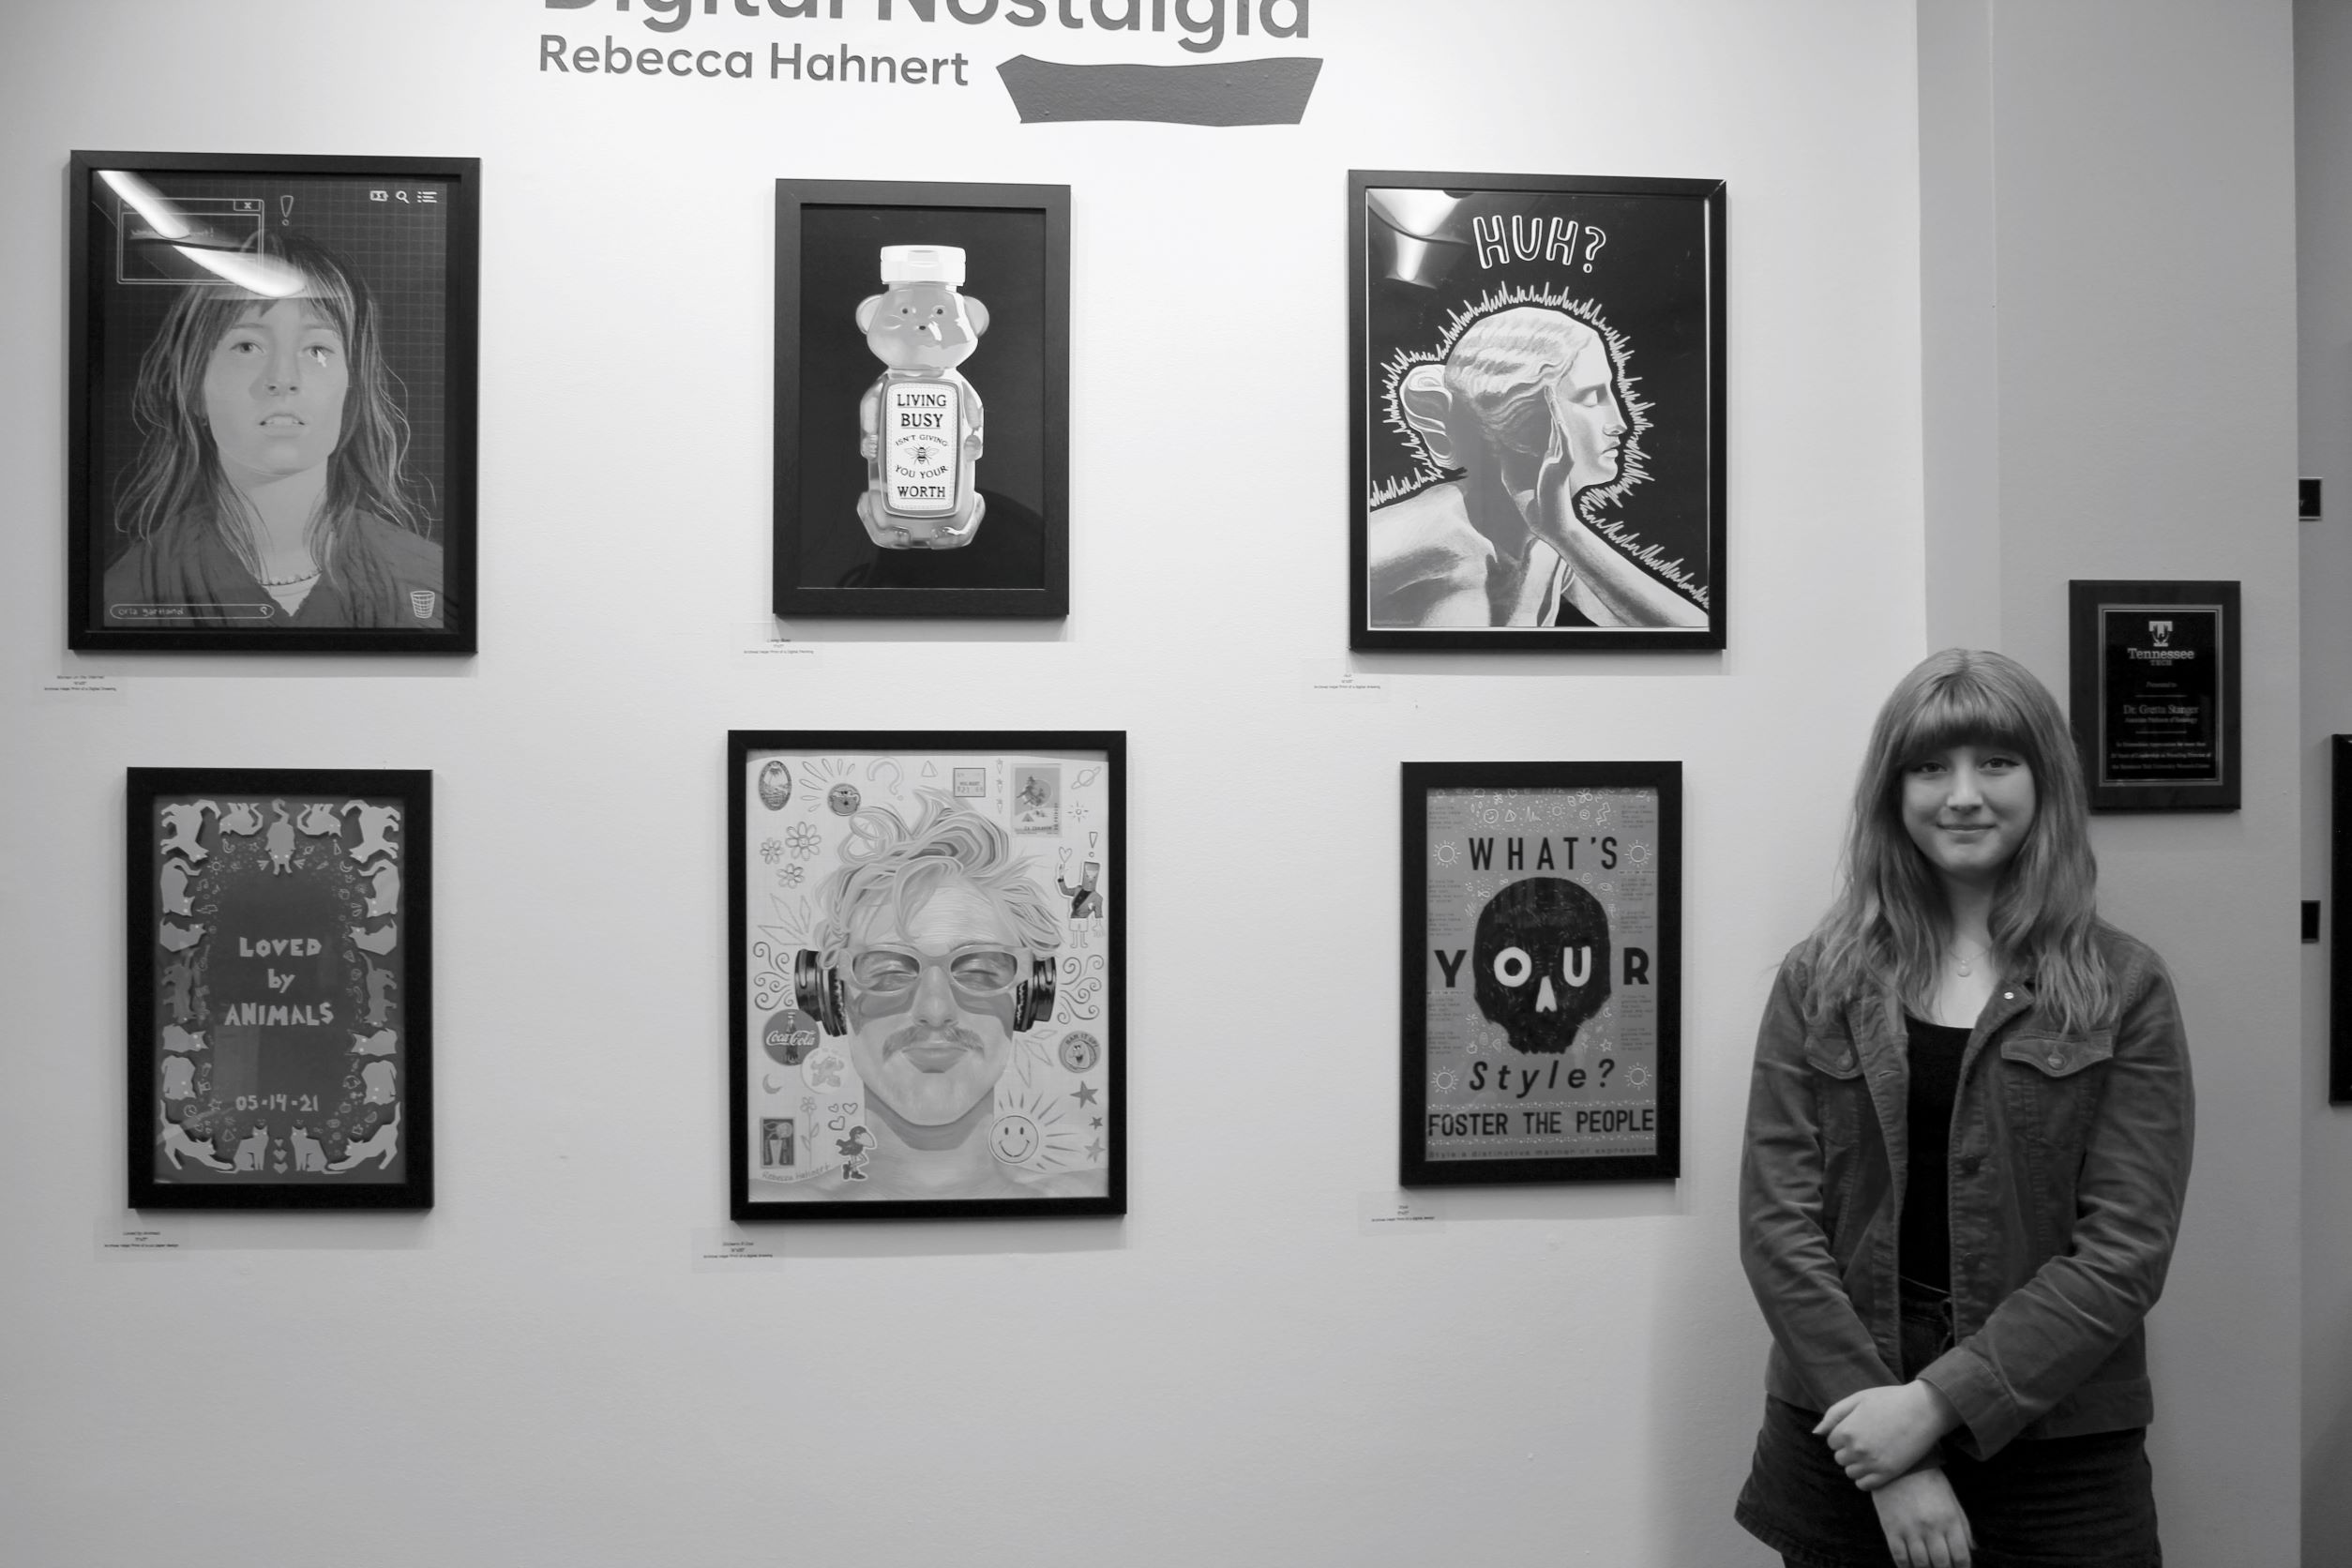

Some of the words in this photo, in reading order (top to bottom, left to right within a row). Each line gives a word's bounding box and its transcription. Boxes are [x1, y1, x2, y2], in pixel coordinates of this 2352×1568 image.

[539, 34, 753, 79] Rebecca
[770, 42, 969, 85] Hahnert
[1472, 215, 1606, 273] HUH?
[897, 394, 946, 406] LIVING
[901, 414, 943, 428] BUSY
[919, 434, 948, 447] GIVING
[895, 464, 915, 478] YOU
[919, 465, 948, 479] YOUR
[897, 486, 945, 498] WORTH
[2127, 647, 2194, 659] Tennessee
[1468, 837, 1619, 870] WHAT'S
[239, 936, 323, 957] LOVED
[267, 968, 295, 994] by
[224, 1002, 335, 1027] ANIMALS
[1469, 1058, 1616, 1099] Style?
[1428, 1112, 1509, 1137] FOSTER
[1523, 1111, 1562, 1134] THE
[1576, 1109, 1655, 1133] PEOPLE
